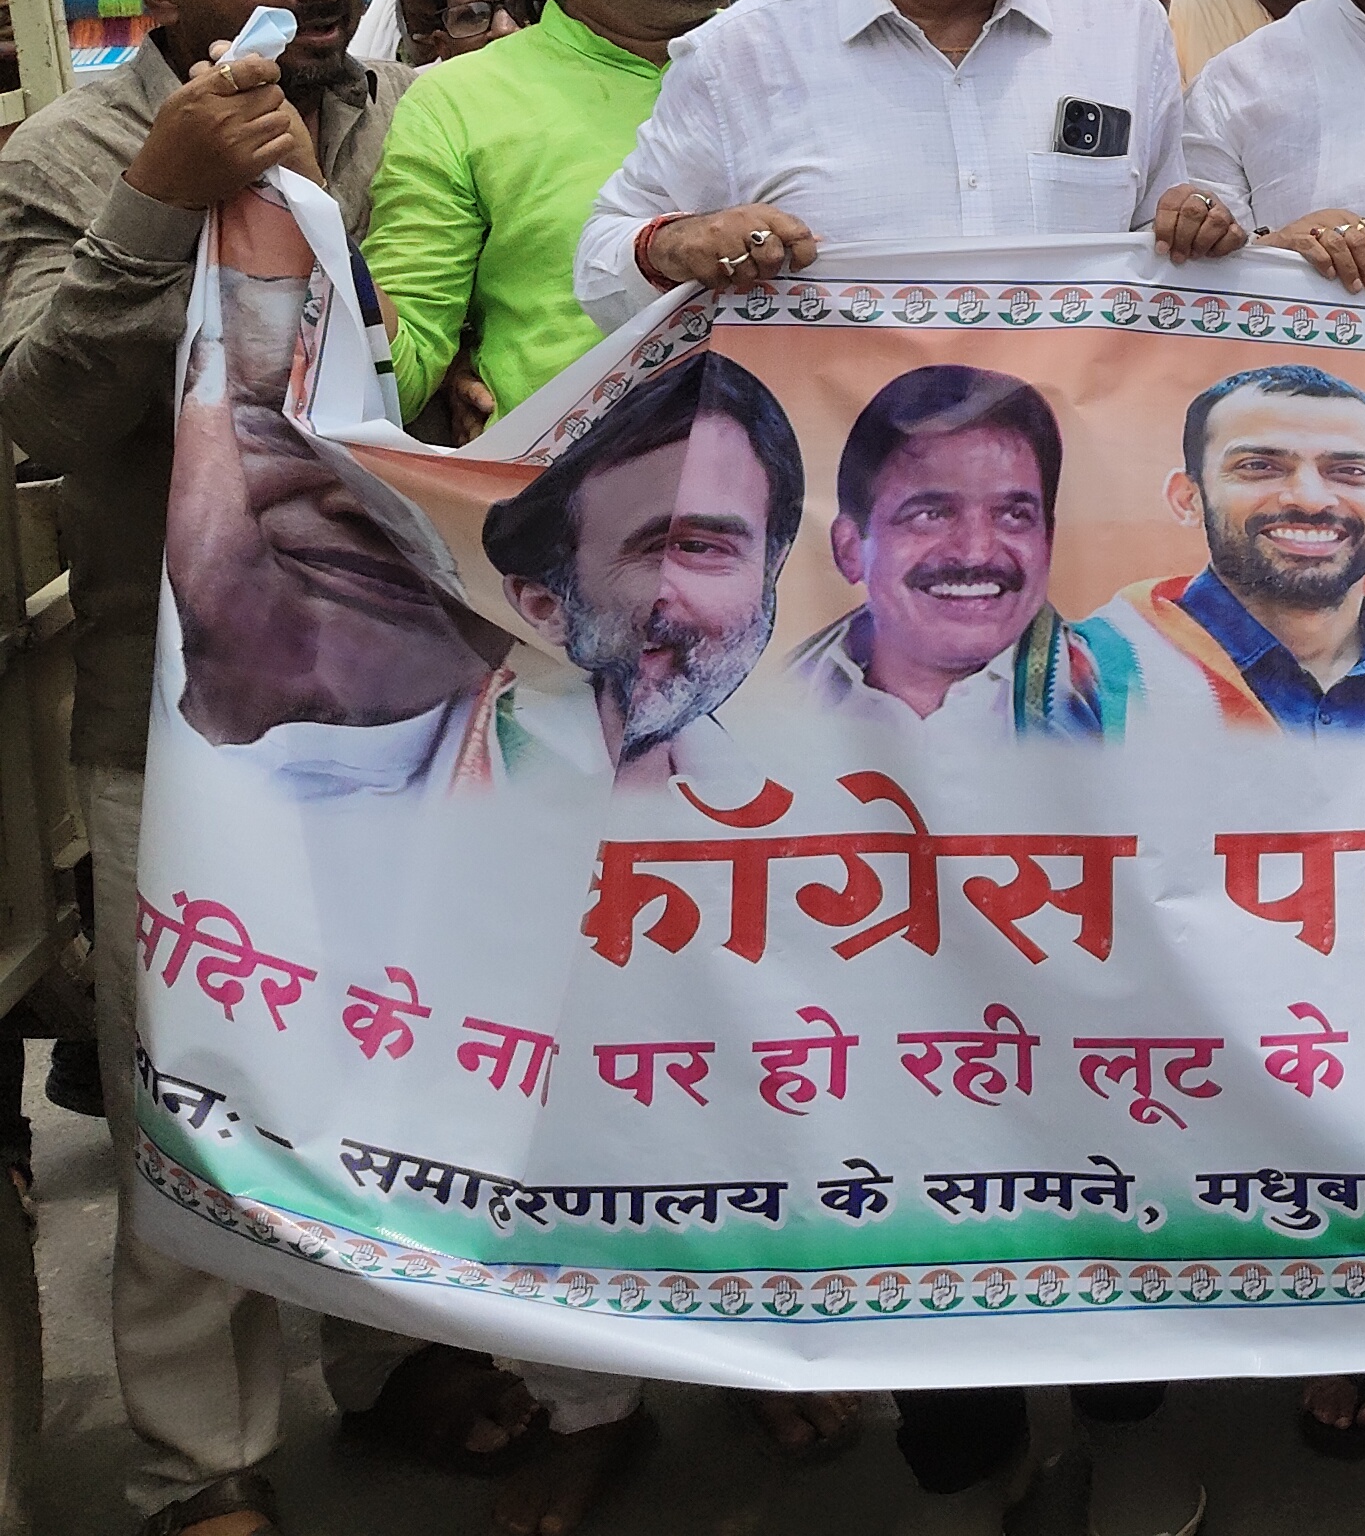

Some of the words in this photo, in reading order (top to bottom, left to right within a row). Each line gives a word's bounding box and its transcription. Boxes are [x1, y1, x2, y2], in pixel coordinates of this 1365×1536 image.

[136, 889, 319, 1032] मंदिर
[342, 966, 432, 1060] के
[456, 1016, 560, 1107] ना
[593, 1041, 715, 1107] पर
[753, 1006, 859, 1115] हो
[898, 1004, 1041, 1106] रही
[1074, 1038, 1225, 1129] लूट
[1261, 1002, 1349, 1099] के
[341, 1138, 788, 1230] समाहरणालय
[818, 1158, 893, 1221] के
[924, 1156, 1159, 1225] सामने,
